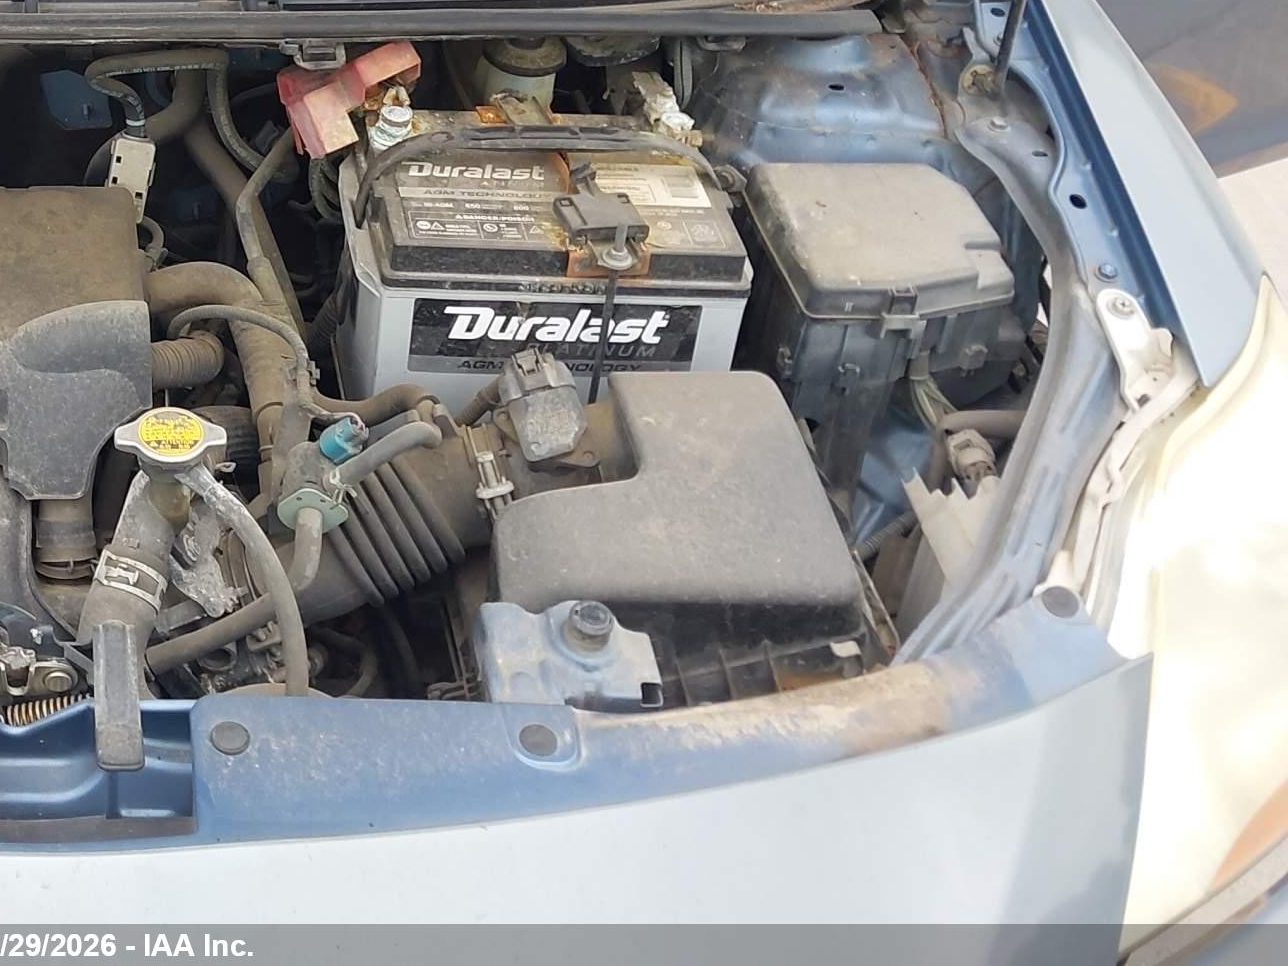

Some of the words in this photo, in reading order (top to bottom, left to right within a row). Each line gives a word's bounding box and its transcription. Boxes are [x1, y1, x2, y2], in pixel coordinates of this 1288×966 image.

[401, 161, 544, 181] Duralast
[444, 306, 669, 344] Duralast
[456, 360, 504, 370] AGM
